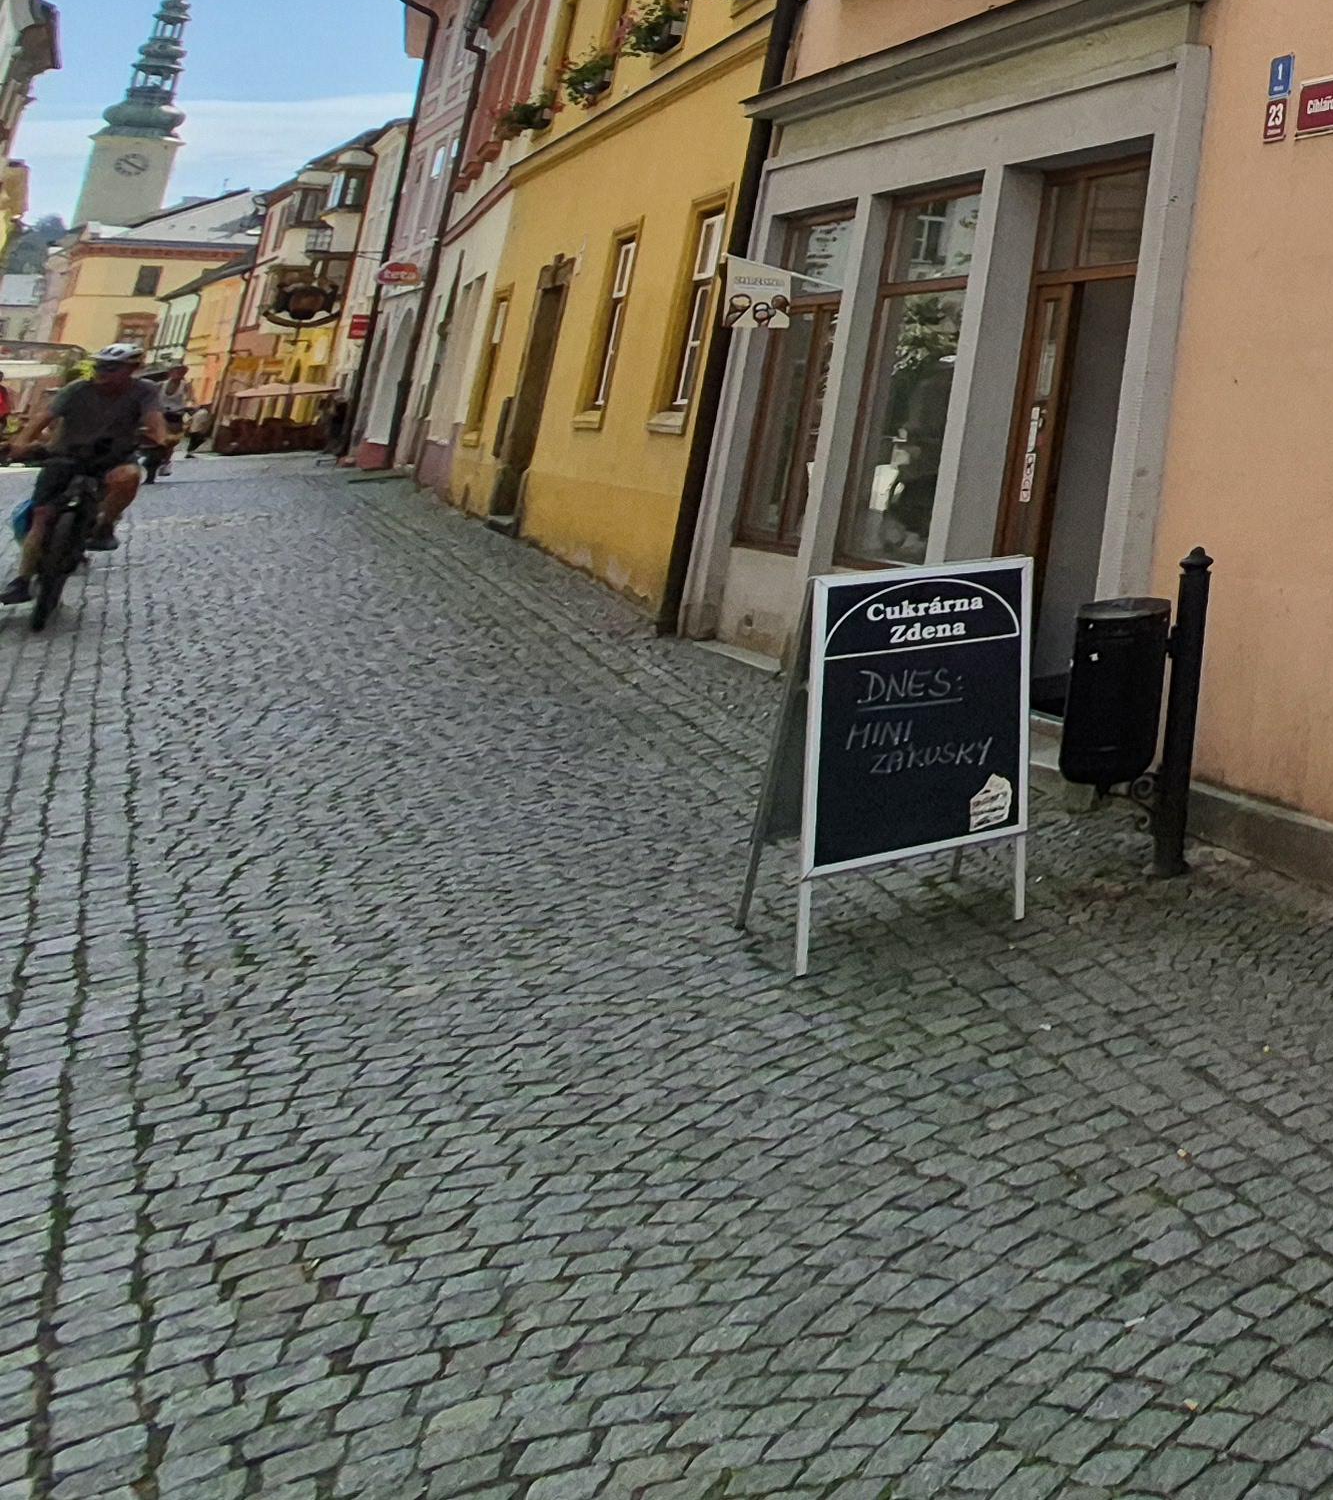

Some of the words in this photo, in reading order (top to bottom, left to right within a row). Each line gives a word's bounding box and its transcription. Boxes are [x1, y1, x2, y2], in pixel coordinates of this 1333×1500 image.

[1277, 63, 1284, 80] 1
[1267, 103, 1284, 126] 23
[866, 596, 984, 621] Cukrárna
[889, 622, 967, 643] Zdena
[856, 668, 964, 704] DNES:
[845, 718, 914, 751] MINI
